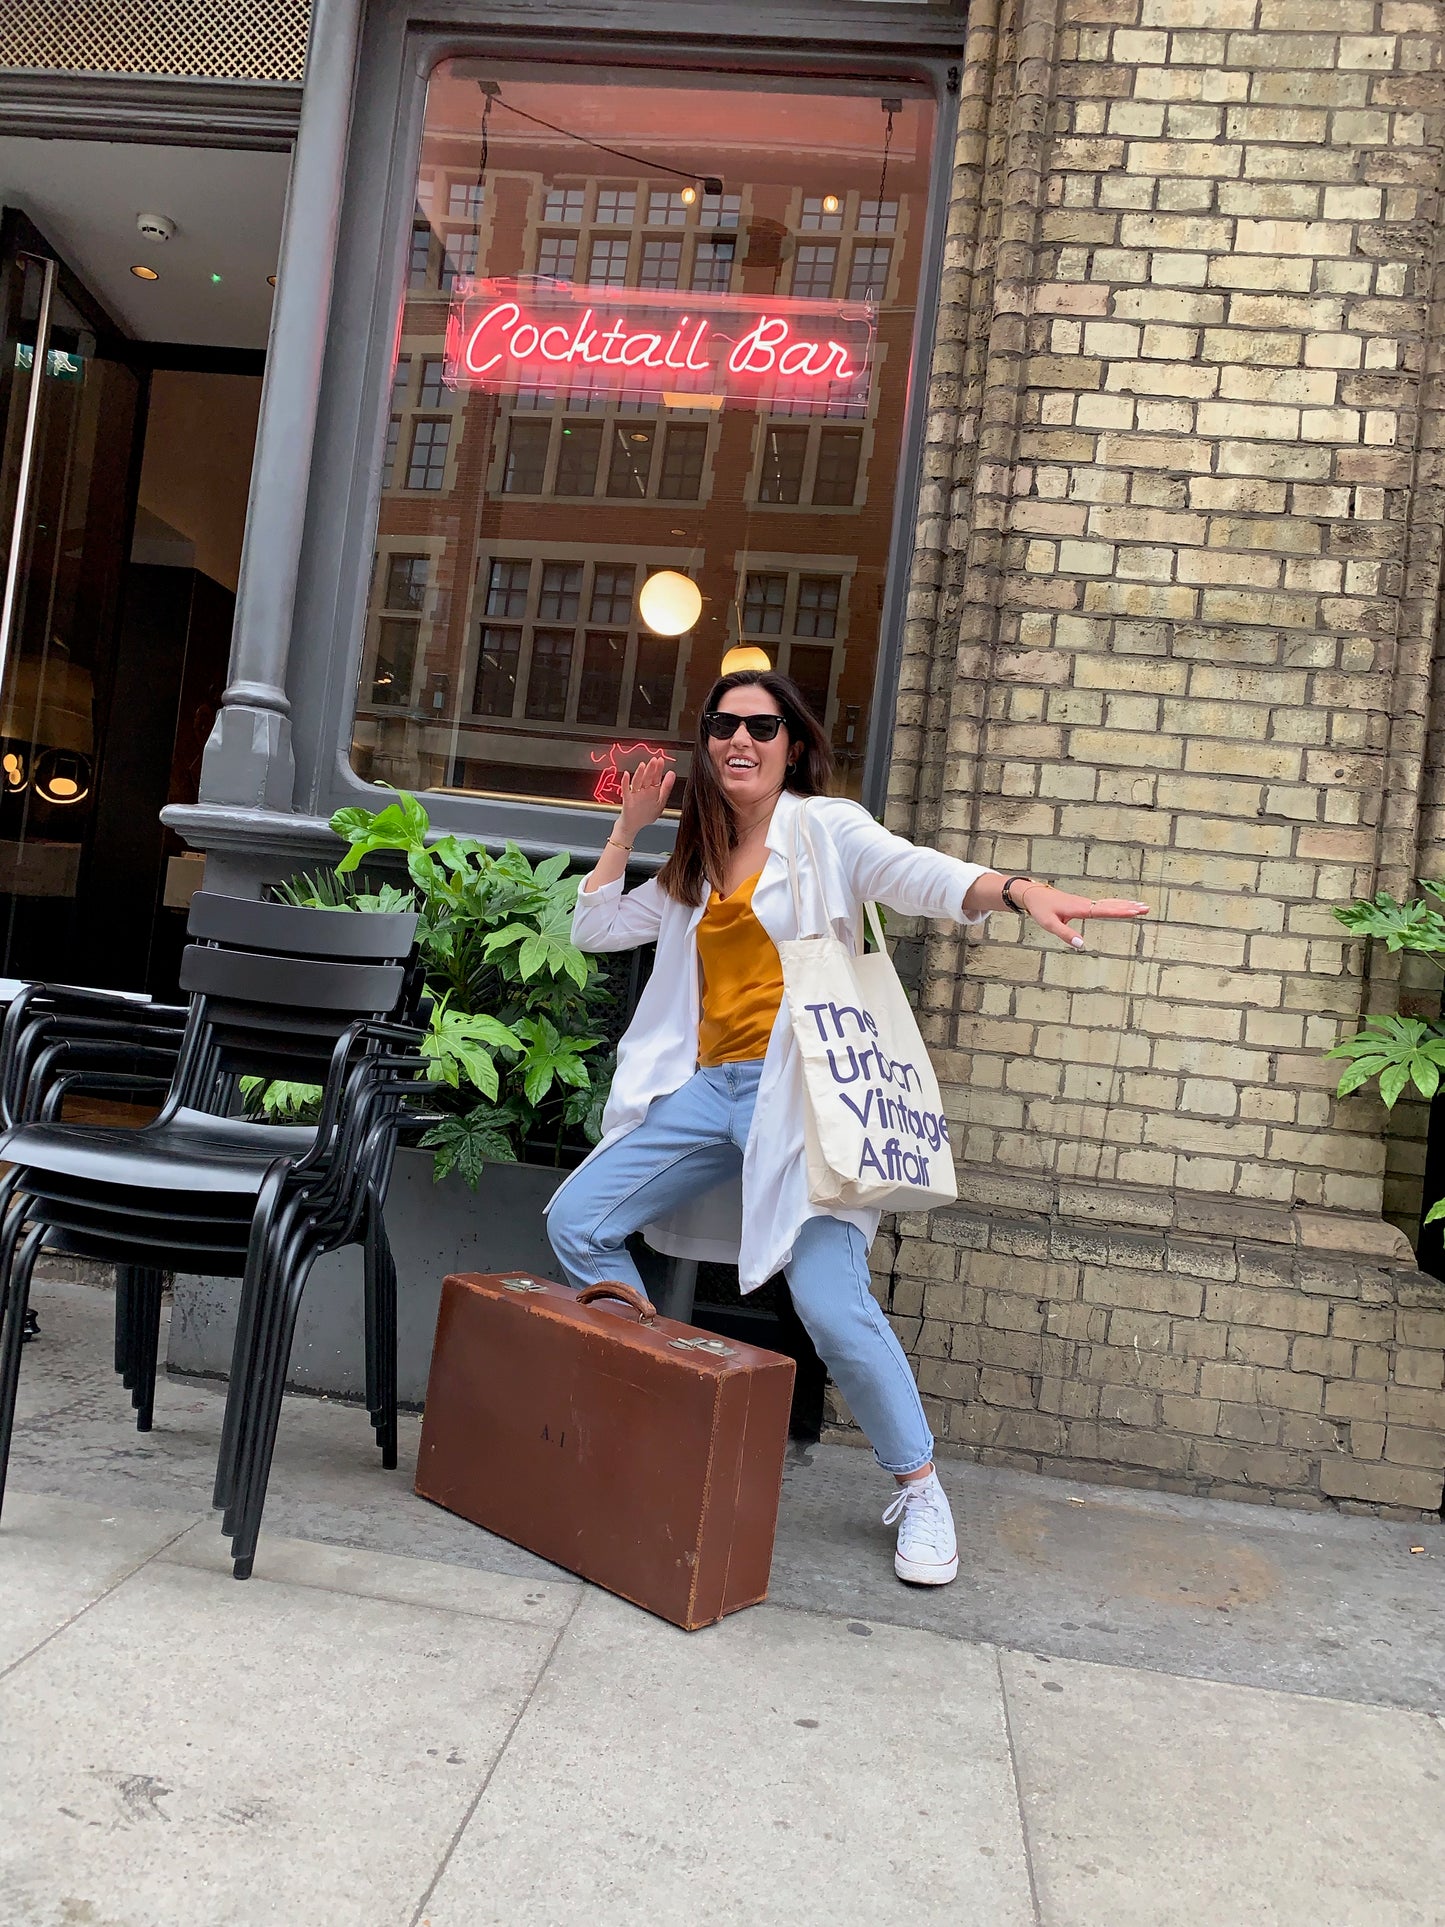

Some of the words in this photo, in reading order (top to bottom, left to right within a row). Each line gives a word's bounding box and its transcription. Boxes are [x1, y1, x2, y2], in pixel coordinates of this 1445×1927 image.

[465, 303, 710, 373] Cocktail
[728, 316, 854, 379] Bar
[804, 1001, 878, 1042] The
[826, 1041, 923, 1094] Urban
[839, 1088, 951, 1152] Vintage
[858, 1137, 930, 1187] Affair
